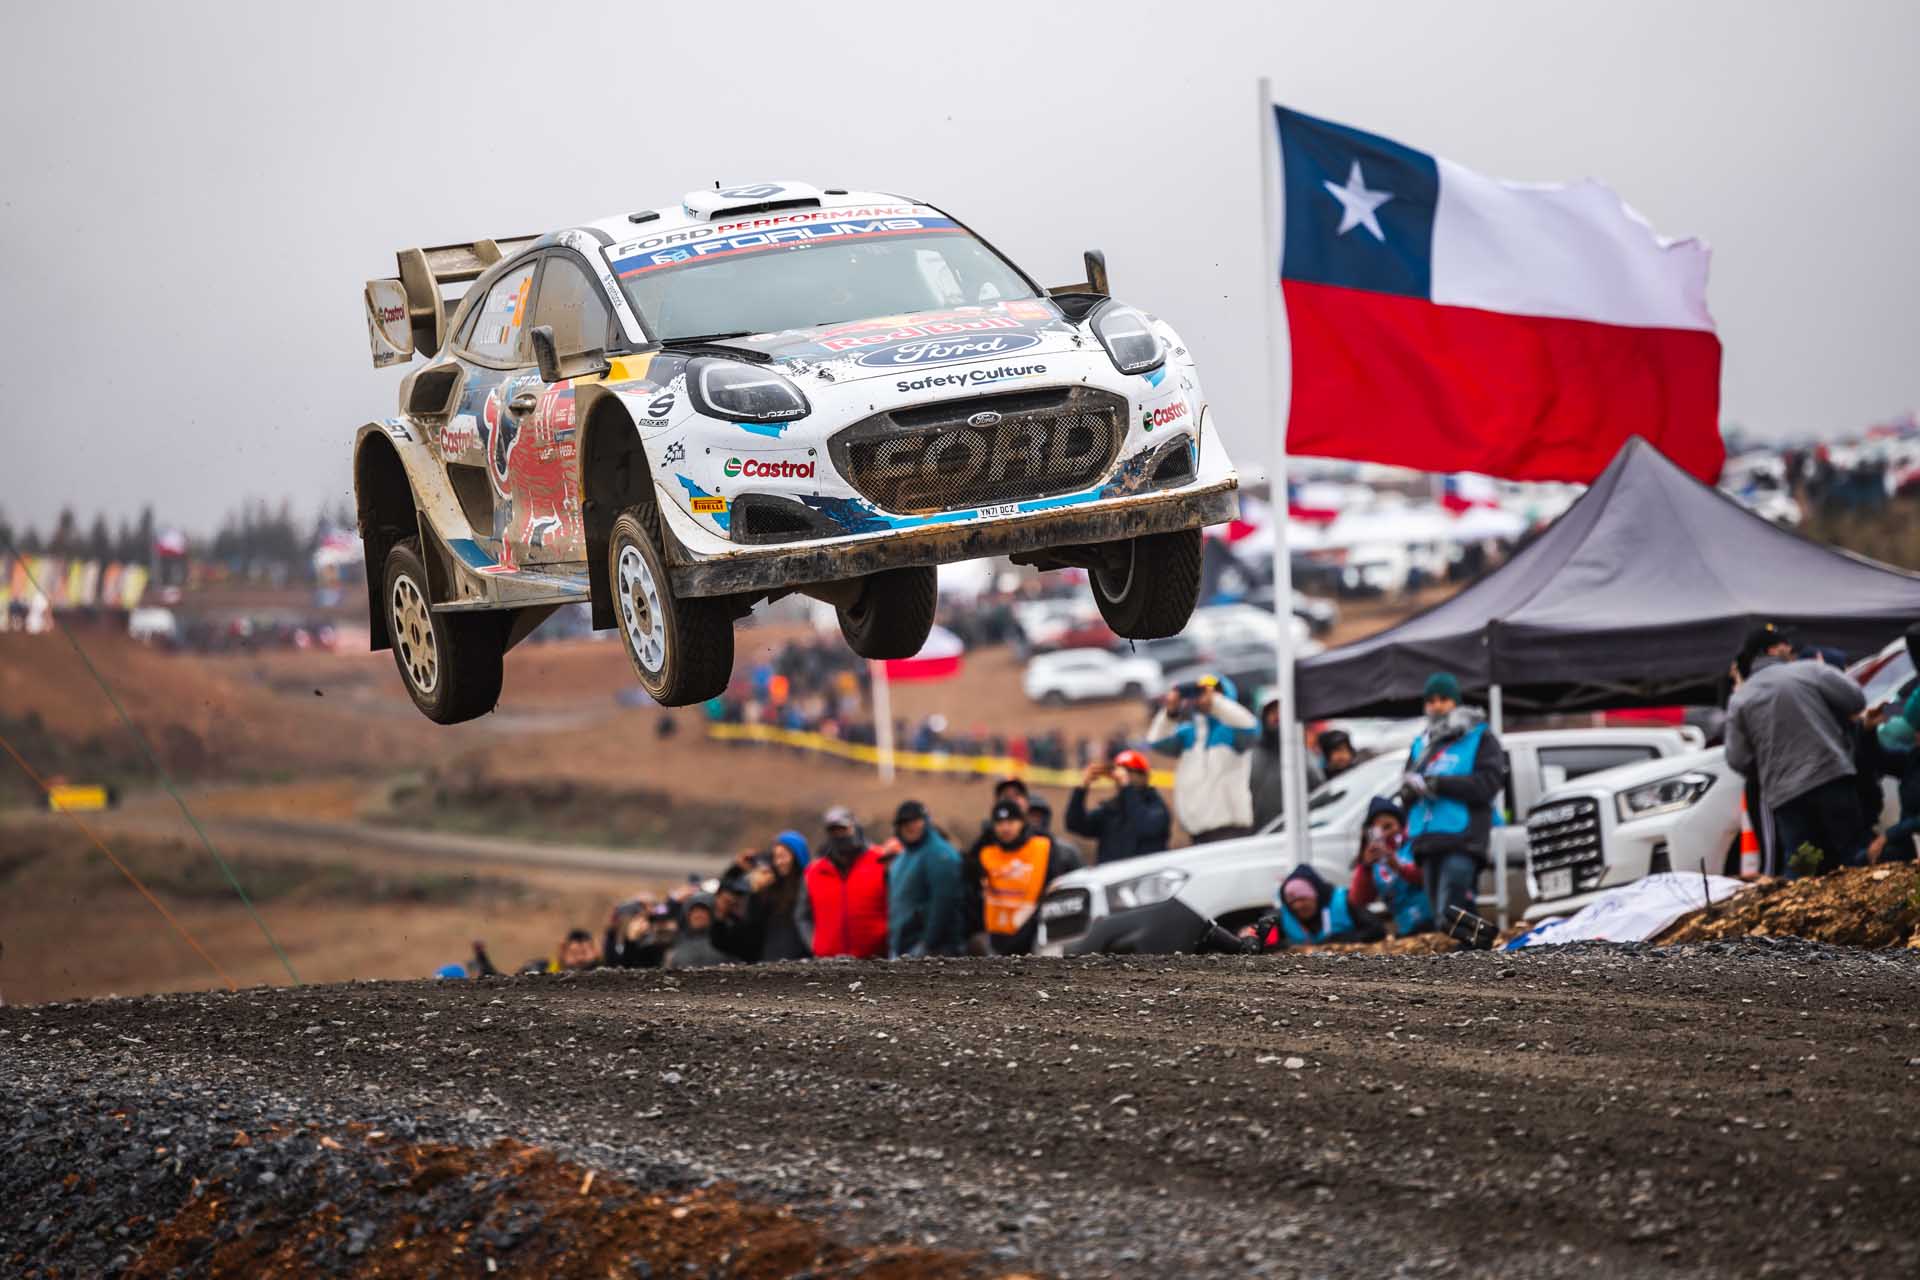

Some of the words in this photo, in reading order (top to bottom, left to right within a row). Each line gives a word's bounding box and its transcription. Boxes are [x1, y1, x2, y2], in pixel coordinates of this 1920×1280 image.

[618, 228, 713, 255] FORD
[717, 207, 928, 234] PERFORMANCE
[692, 219, 924, 255] FORUM8
[383, 304, 406, 323] Castrol
[893, 336, 1009, 363] Ford
[896, 364, 1047, 393] SafetyCulture
[975, 413, 997, 426] Ford
[866, 414, 1109, 487] FORD
[743, 458, 815, 478] Castrol
[693, 500, 724, 511] PIRELLI
